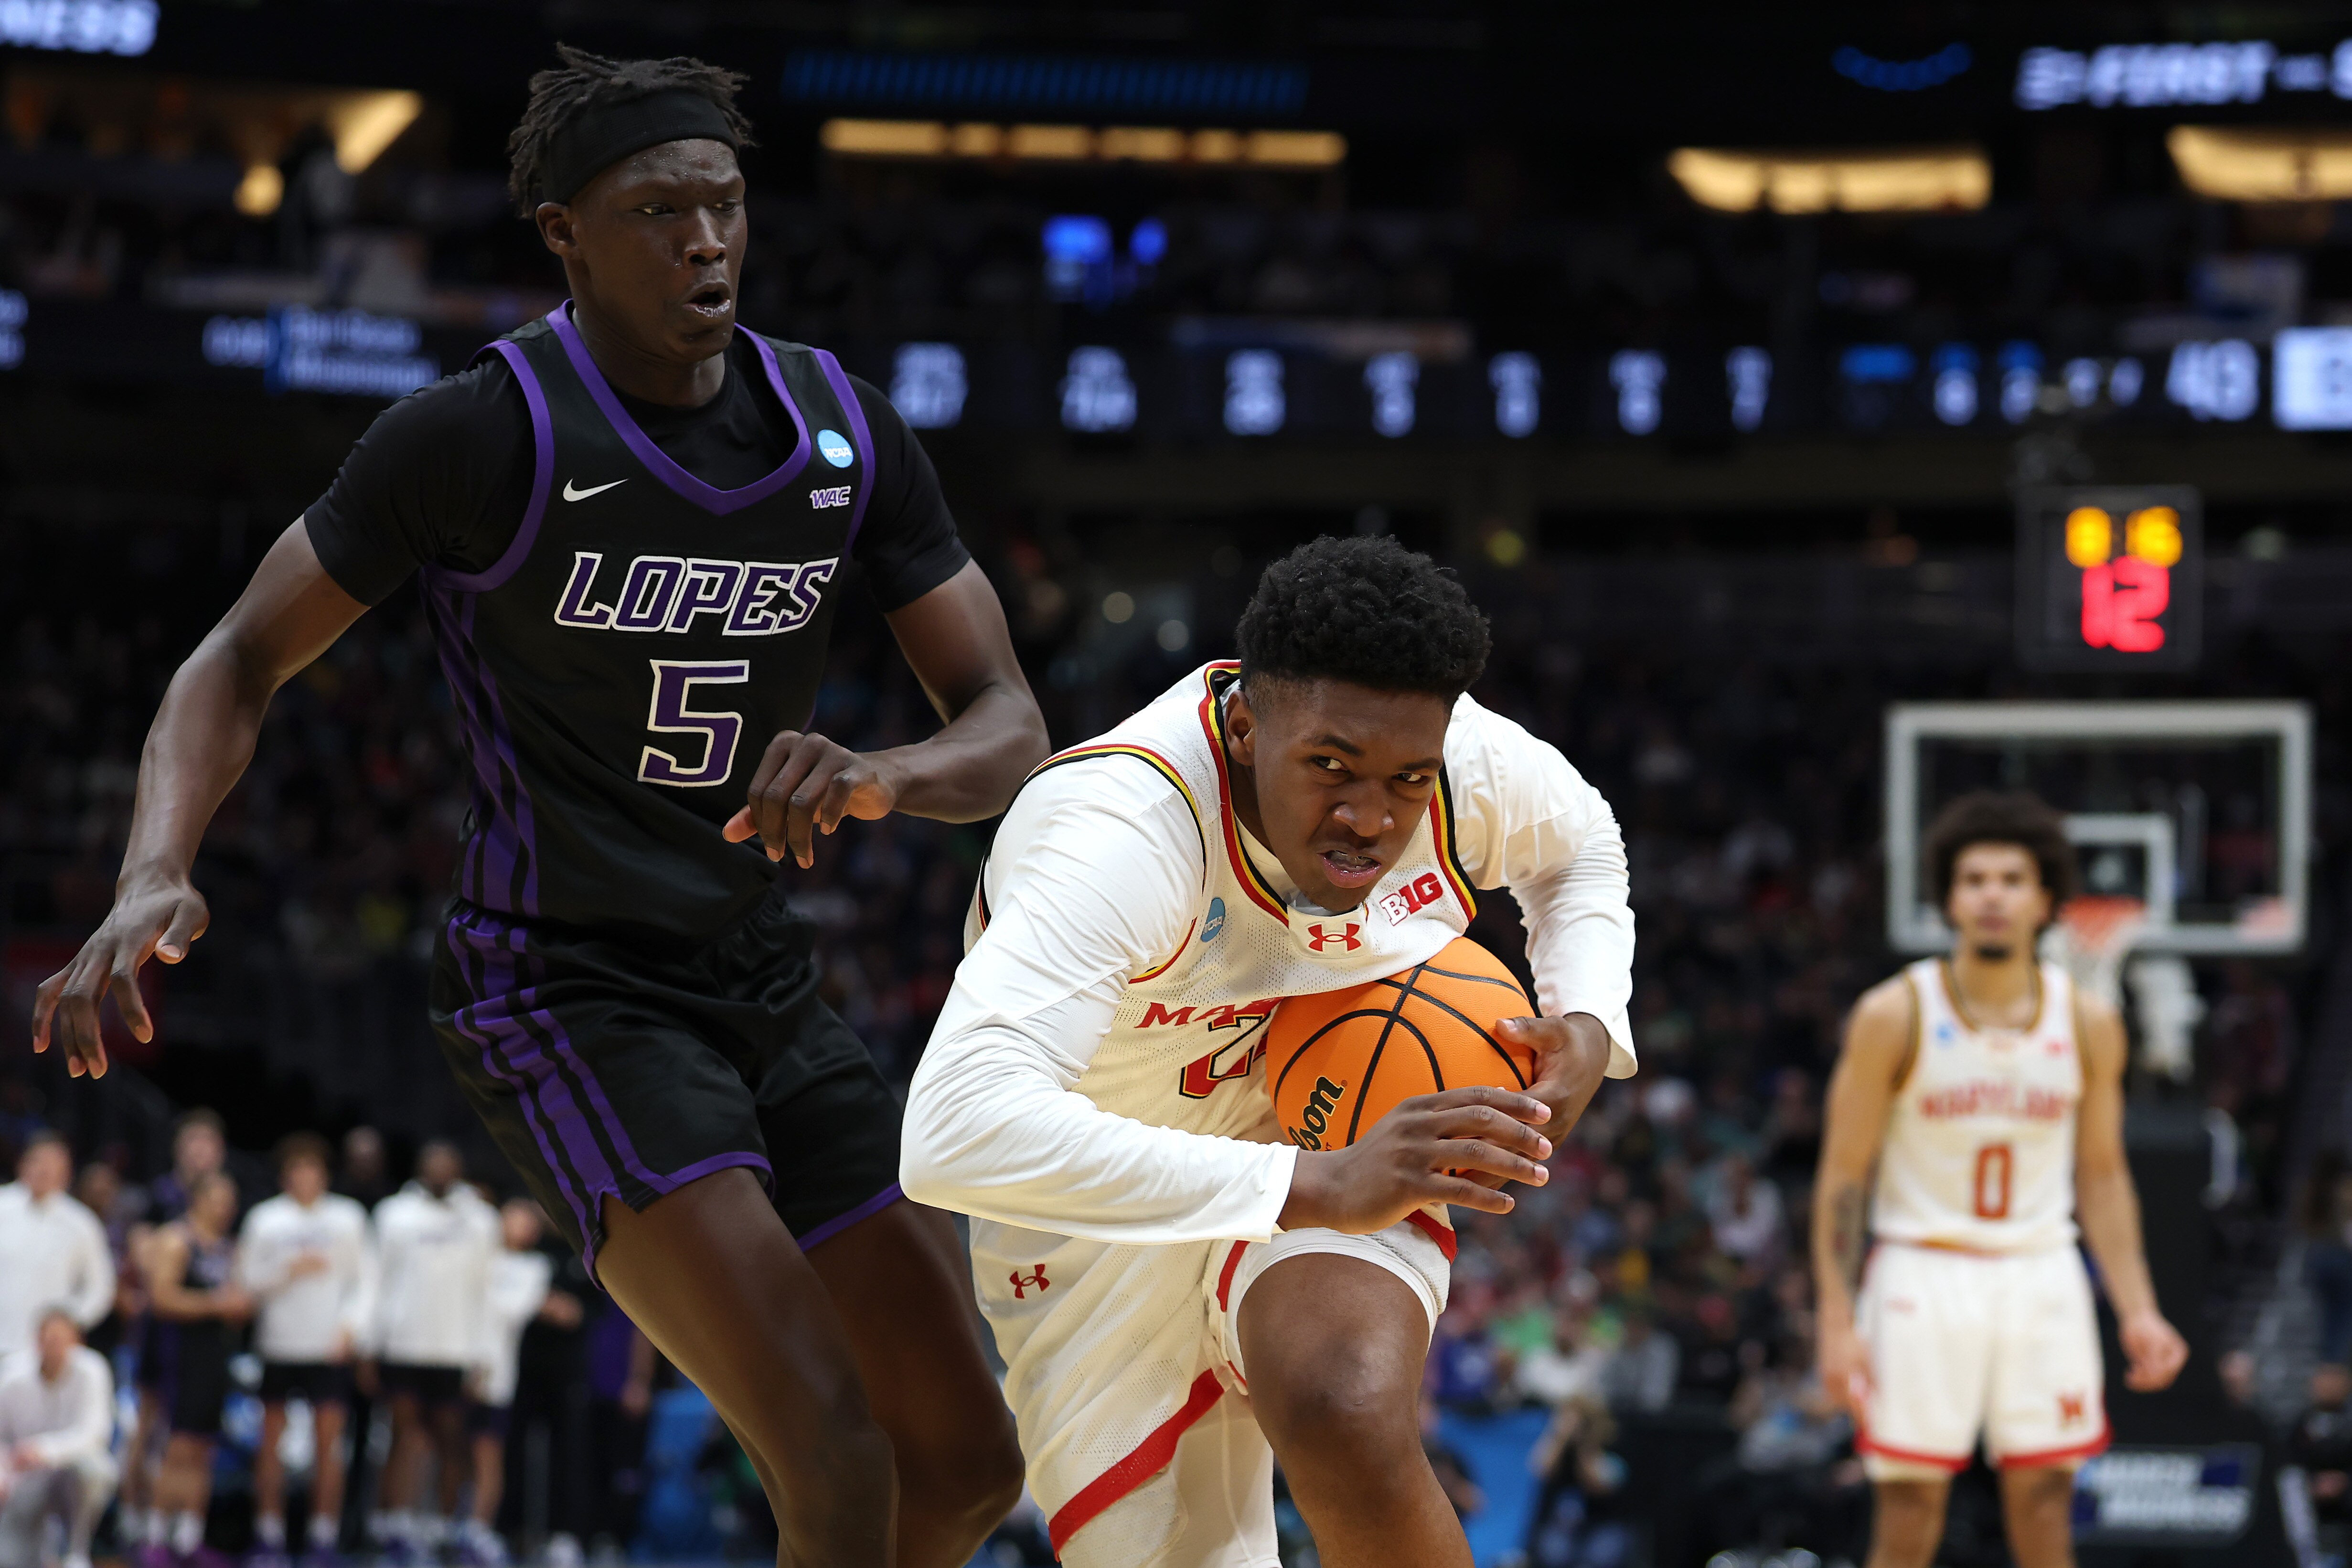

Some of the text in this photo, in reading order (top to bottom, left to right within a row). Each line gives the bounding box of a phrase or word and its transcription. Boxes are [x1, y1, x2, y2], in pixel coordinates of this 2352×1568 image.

[823, 447, 853, 459] NCAA
[809, 485, 852, 510] WAC
[554, 551, 839, 636] LOPES
[638, 659, 750, 788] 5
[1975, 1144, 2012, 1220] 0
